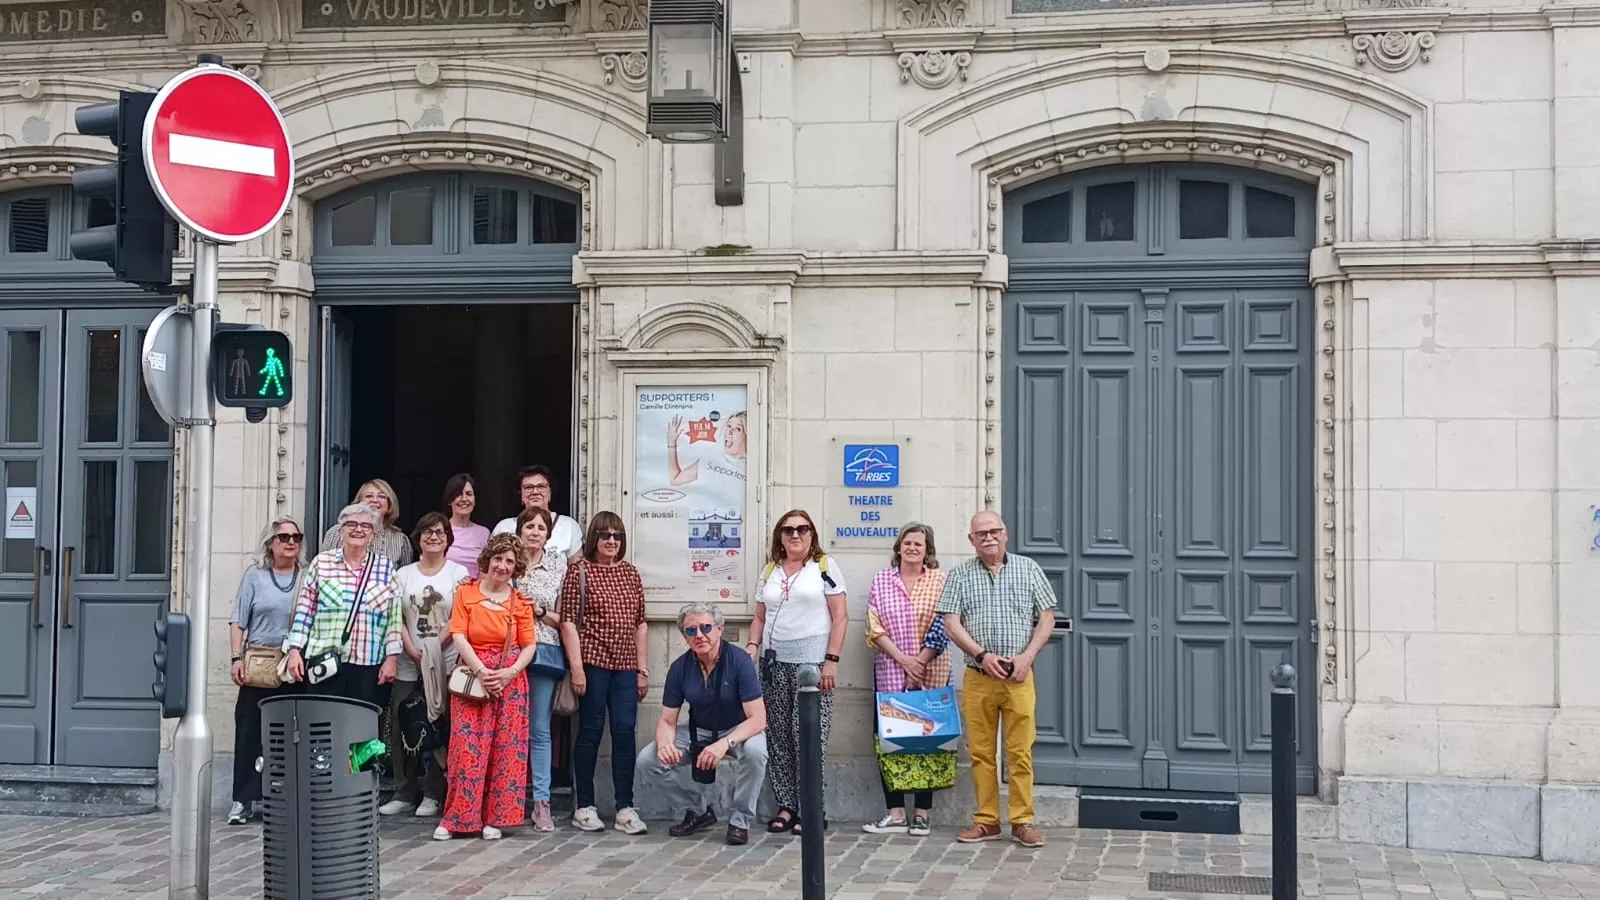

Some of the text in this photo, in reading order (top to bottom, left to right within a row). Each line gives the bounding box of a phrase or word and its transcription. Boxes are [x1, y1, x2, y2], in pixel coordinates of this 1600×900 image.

[346, 0, 525, 20] VAUDEVILLE
[0, 8, 108, 34] MEDIE
[855, 472, 892, 482] TARBES
[848, 495, 893, 505] THEATRE
[861, 511, 880, 521] DES
[836, 527, 899, 537] NOUVEAUTE
